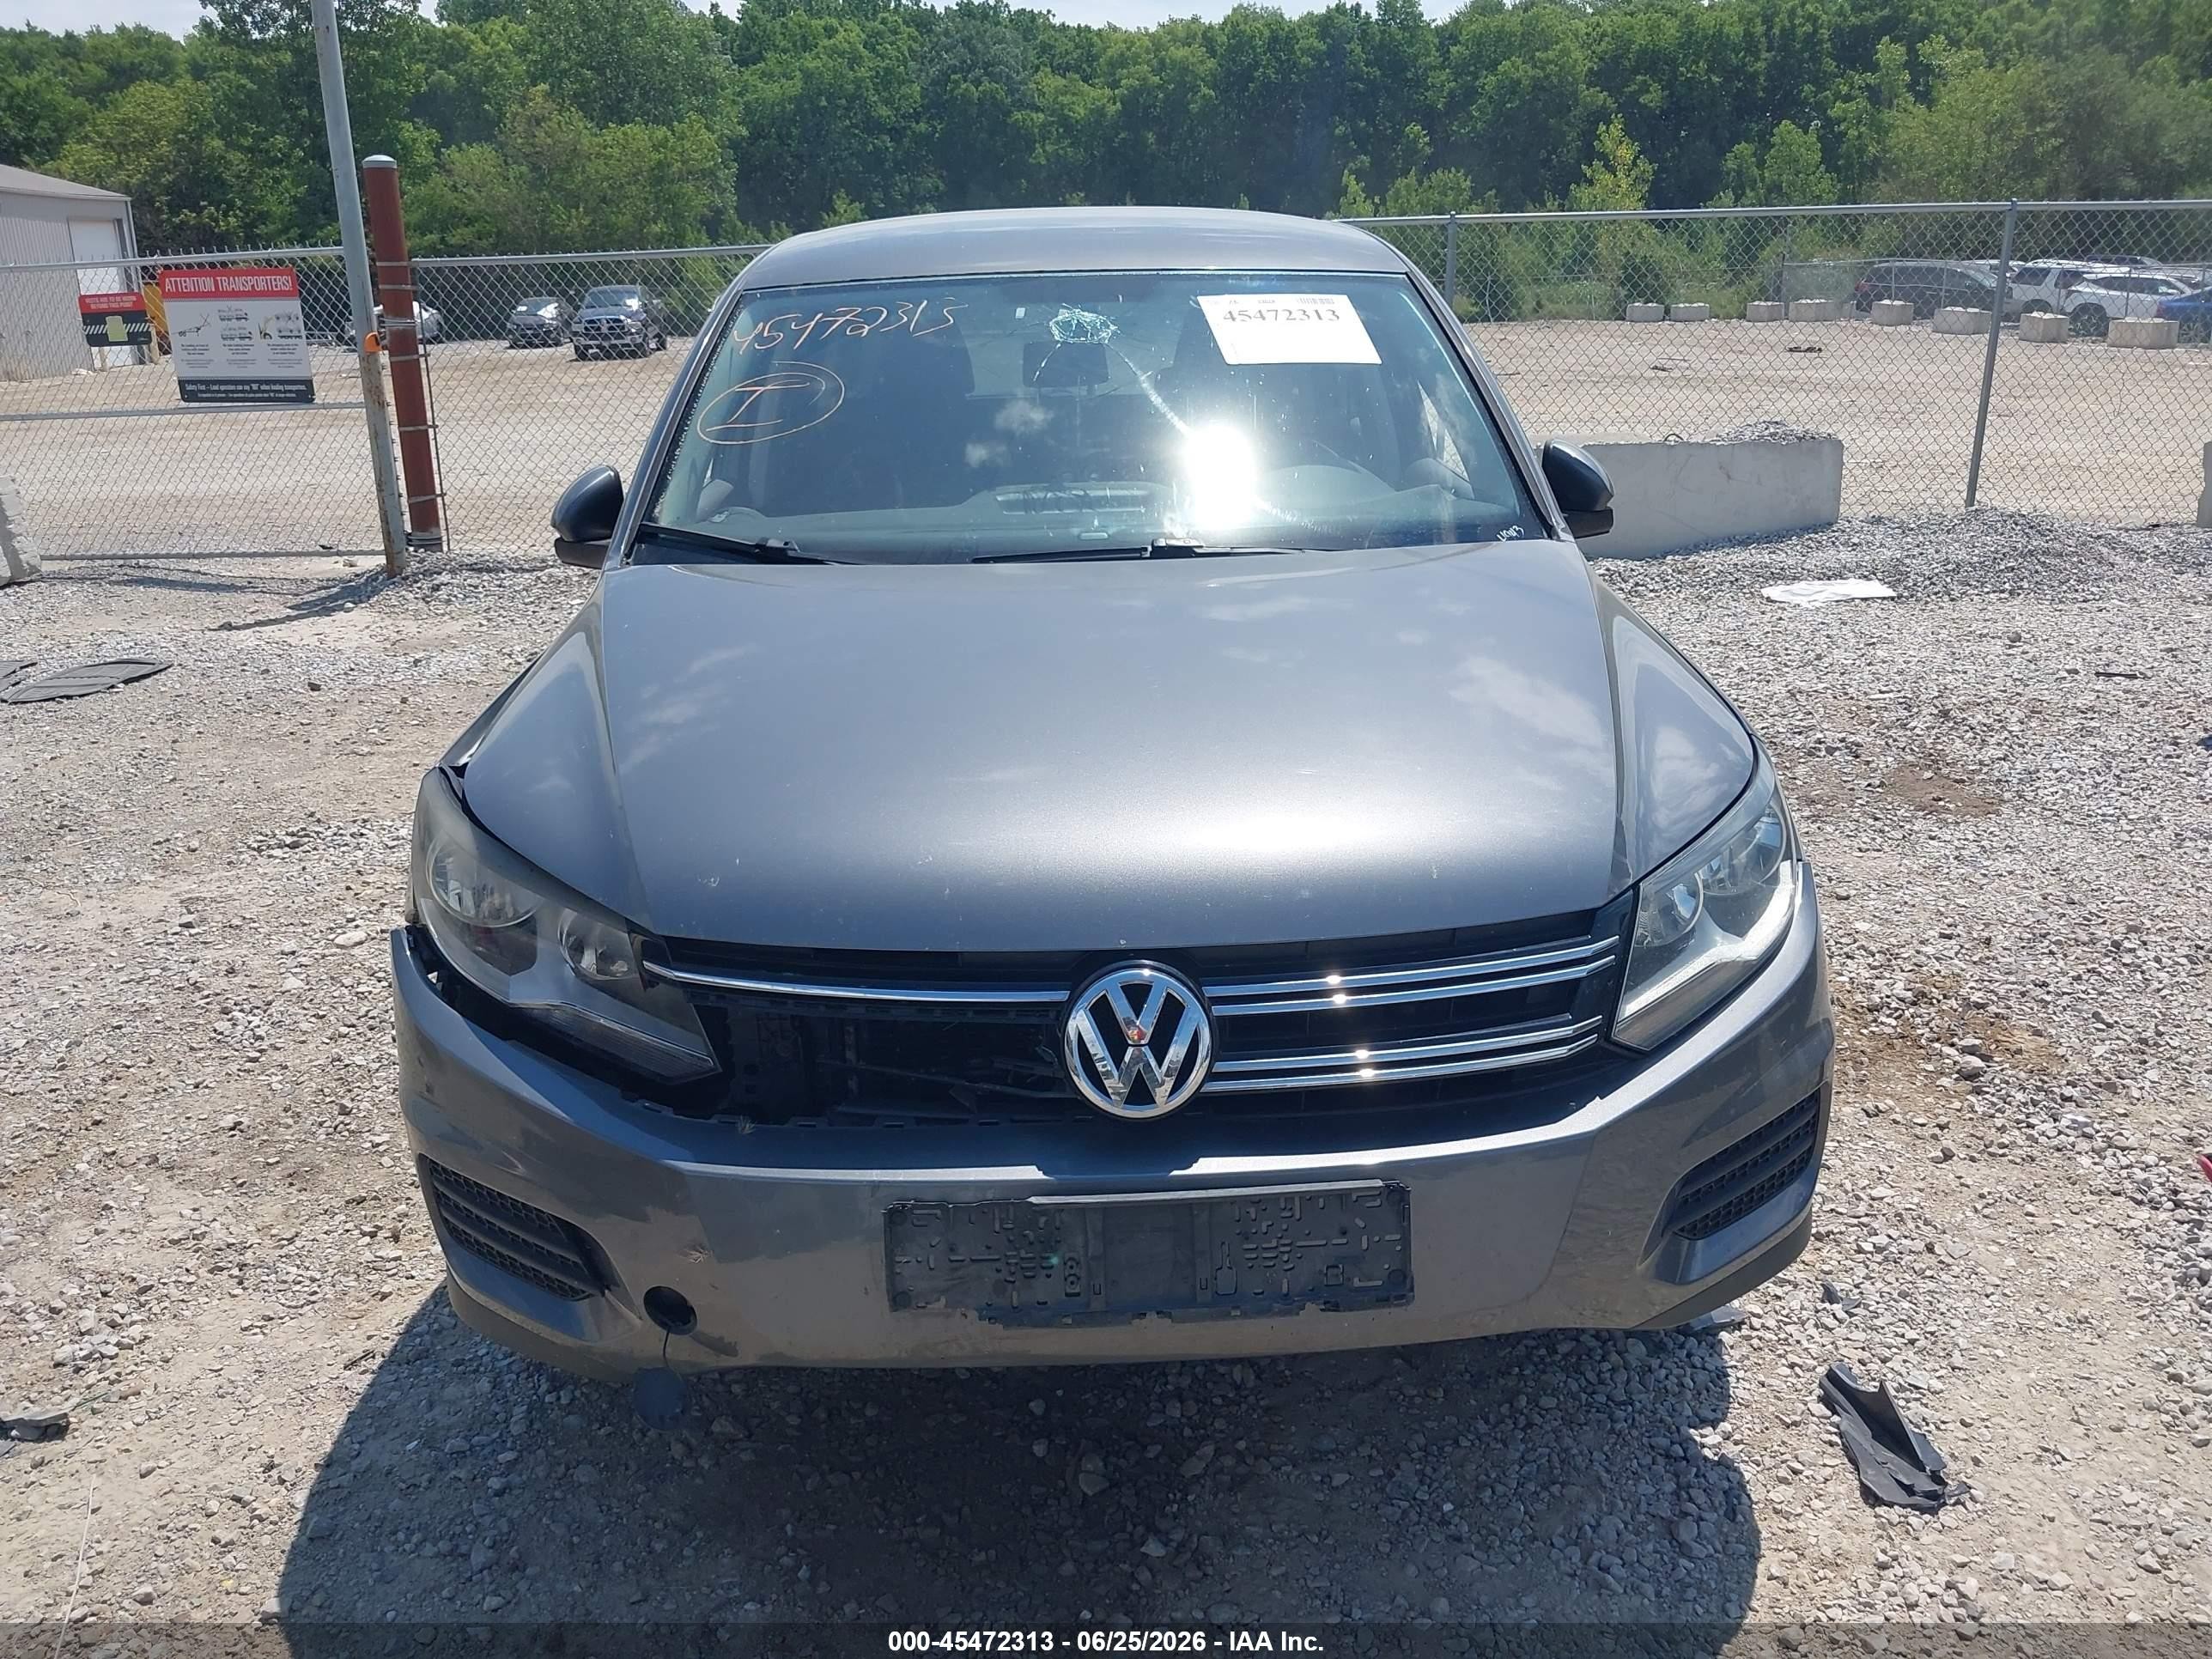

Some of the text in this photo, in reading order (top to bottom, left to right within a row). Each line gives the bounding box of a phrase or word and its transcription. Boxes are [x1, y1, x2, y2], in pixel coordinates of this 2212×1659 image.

[165, 275, 294, 293] ATTENTION TRANSPORTERS!
[1222, 308, 1340, 323] 45472313
